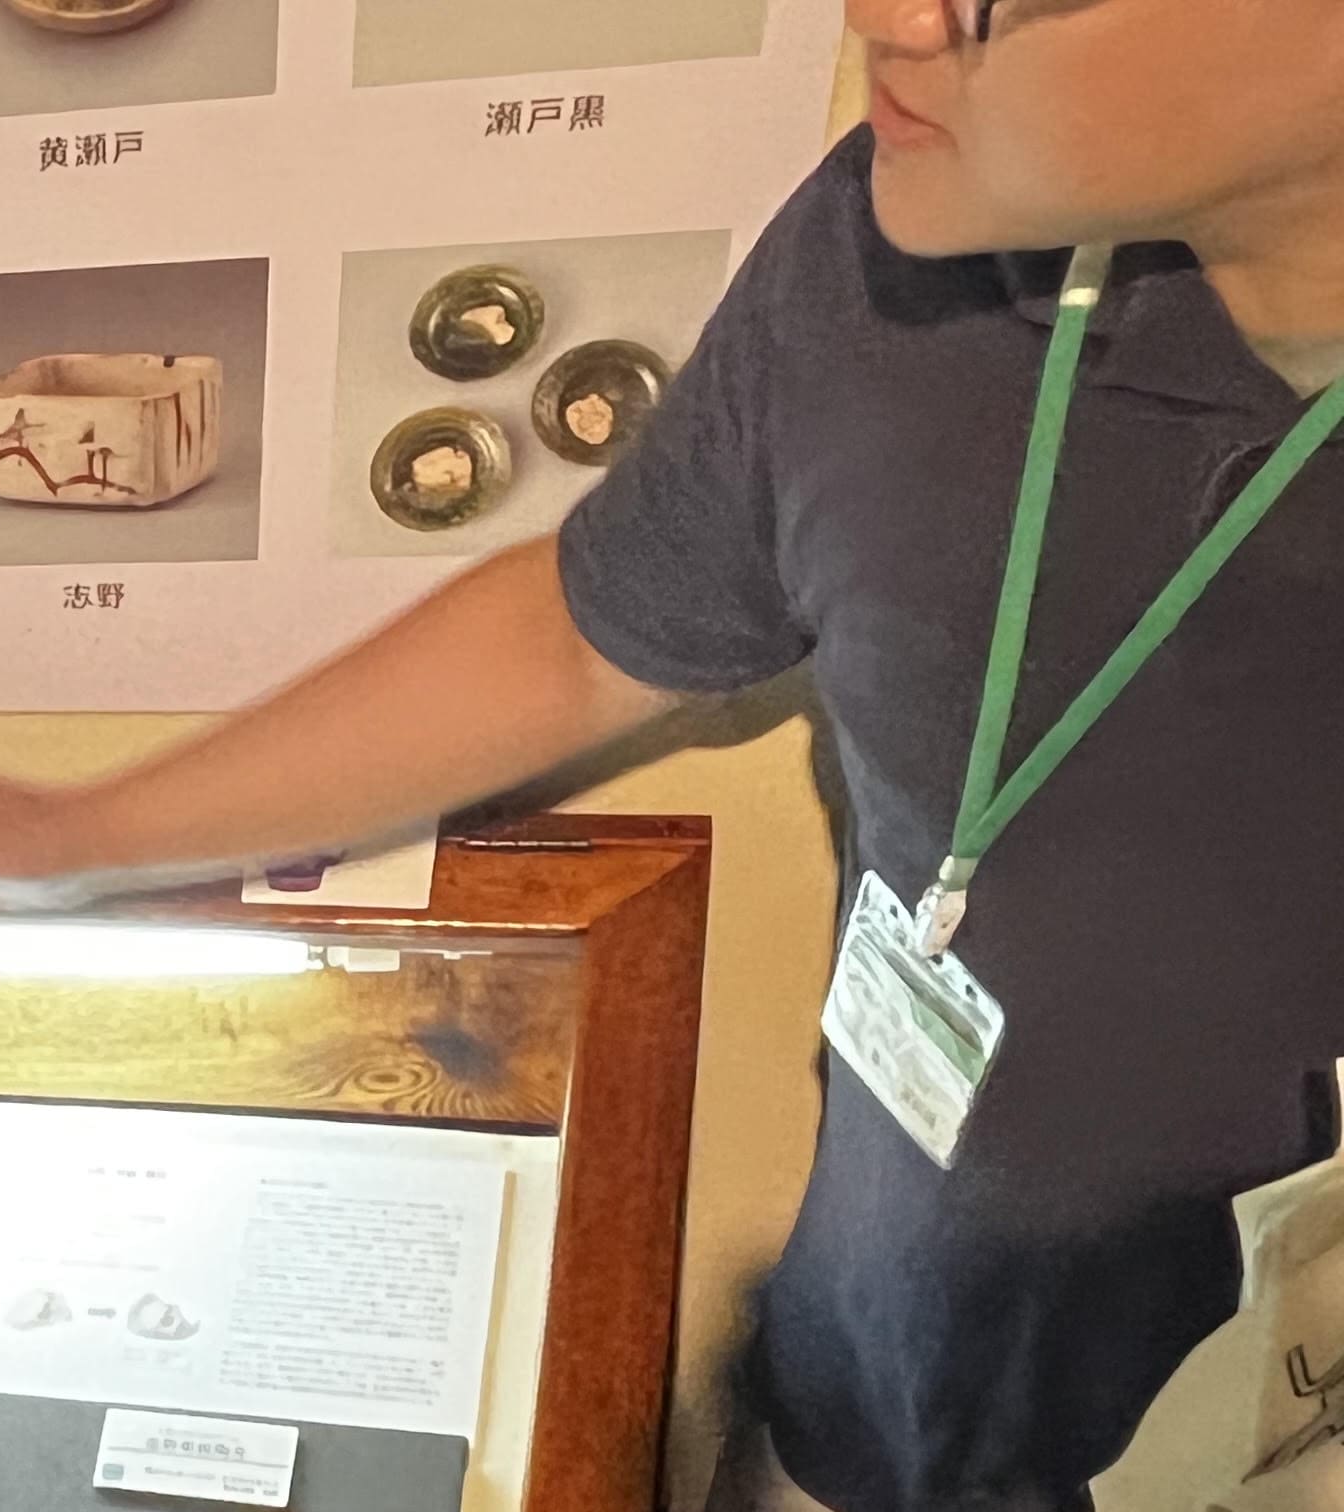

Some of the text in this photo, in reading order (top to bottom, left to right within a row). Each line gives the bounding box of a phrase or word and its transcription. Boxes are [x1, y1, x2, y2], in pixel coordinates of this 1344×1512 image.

[484, 95, 605, 136] 瀬戸黒
[39, 131, 144, 172] 黄瀬戸
[63, 583, 125, 609] 志野
